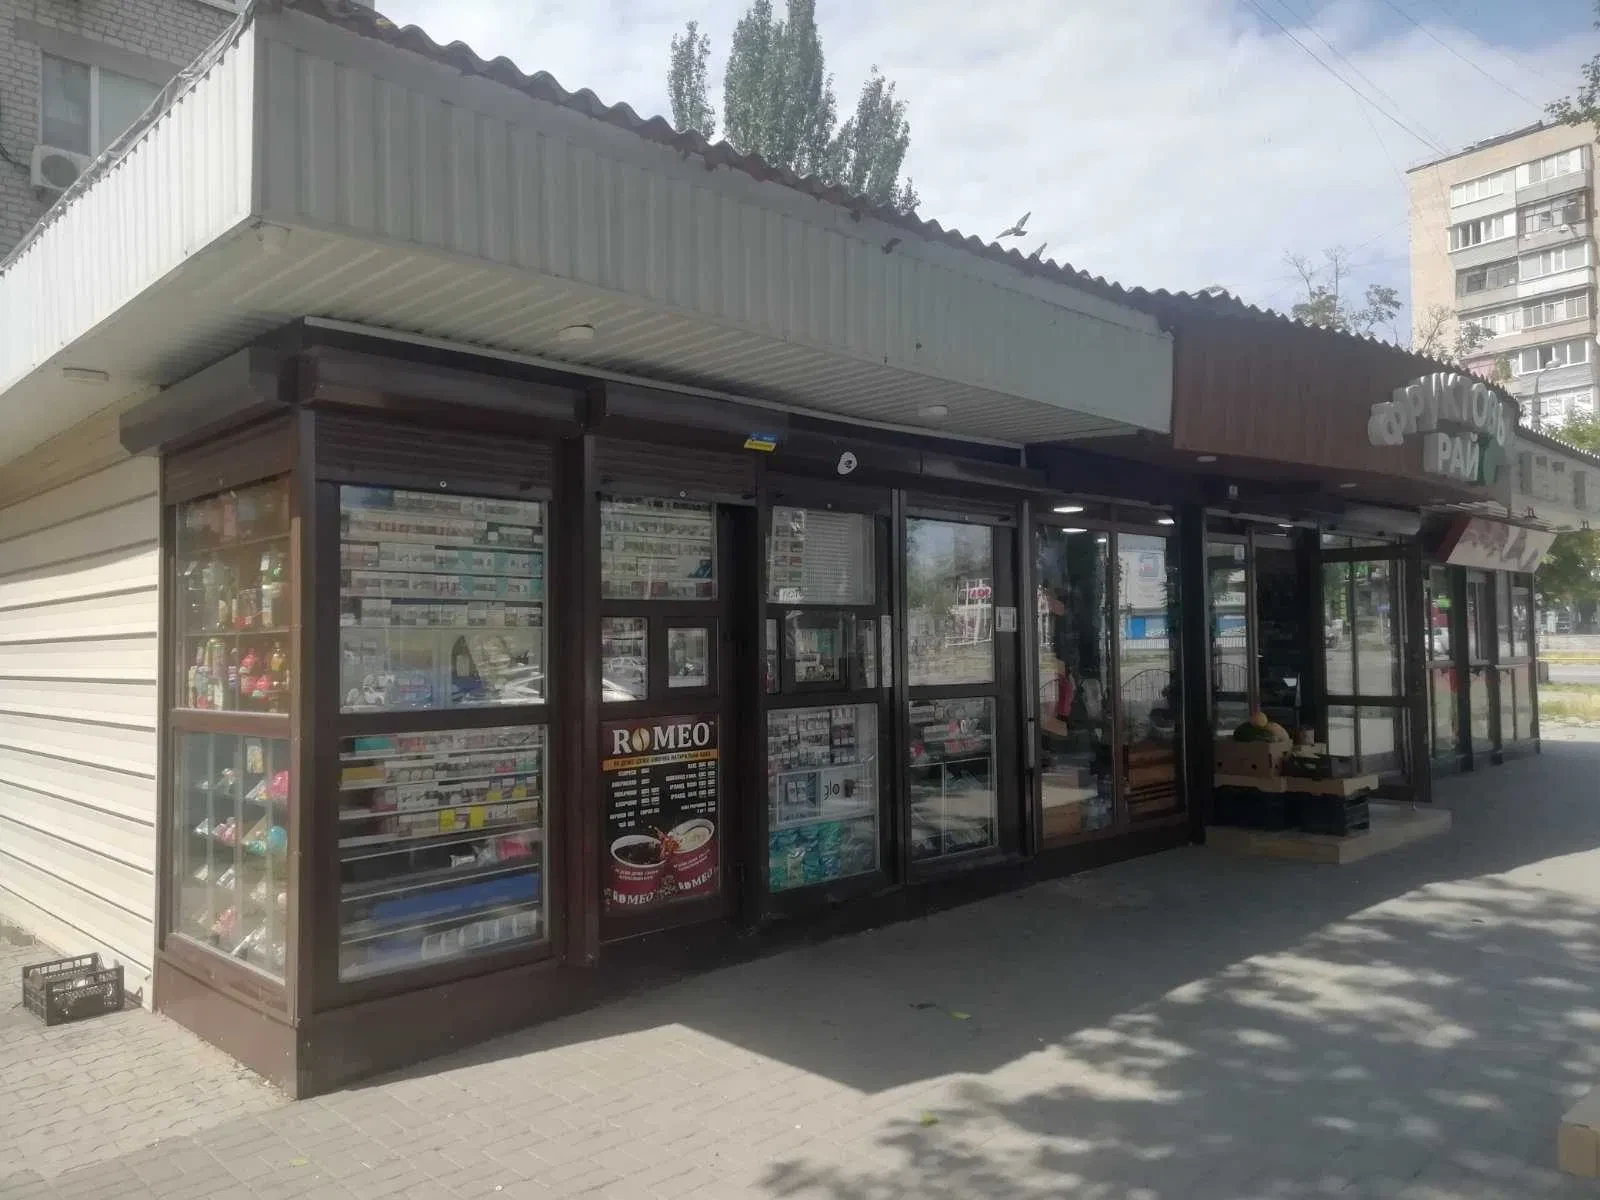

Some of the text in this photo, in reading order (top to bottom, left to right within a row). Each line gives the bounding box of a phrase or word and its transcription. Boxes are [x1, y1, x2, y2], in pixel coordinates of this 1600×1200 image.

[1427, 432, 1479, 481] РАЙ
[612, 721, 710, 755] ROMEO
[823, 778, 841, 800] glo
